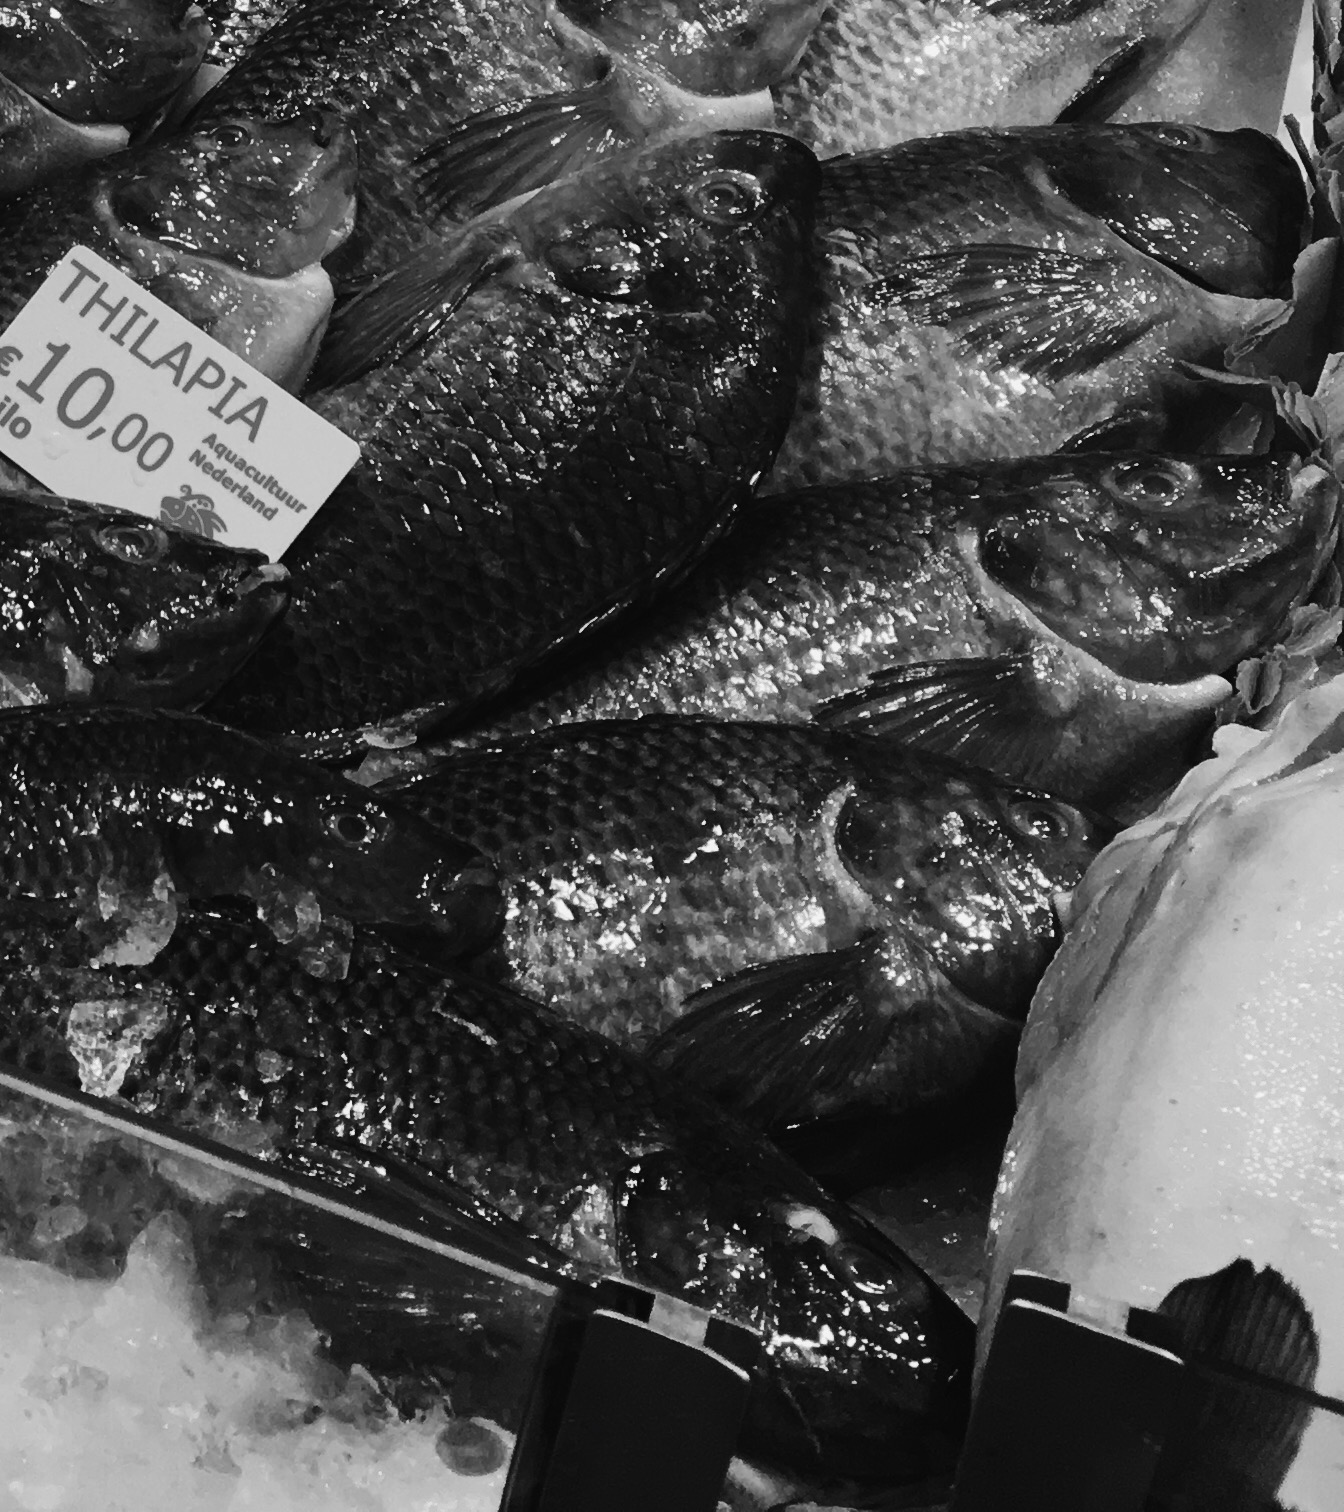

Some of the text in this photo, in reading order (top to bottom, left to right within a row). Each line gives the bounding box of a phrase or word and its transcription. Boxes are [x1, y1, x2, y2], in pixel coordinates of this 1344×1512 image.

[58, 258, 270, 443] THILAPIA
[188, 449, 280, 522] Nederland
[201, 433, 308, 516] Aquacultuur
